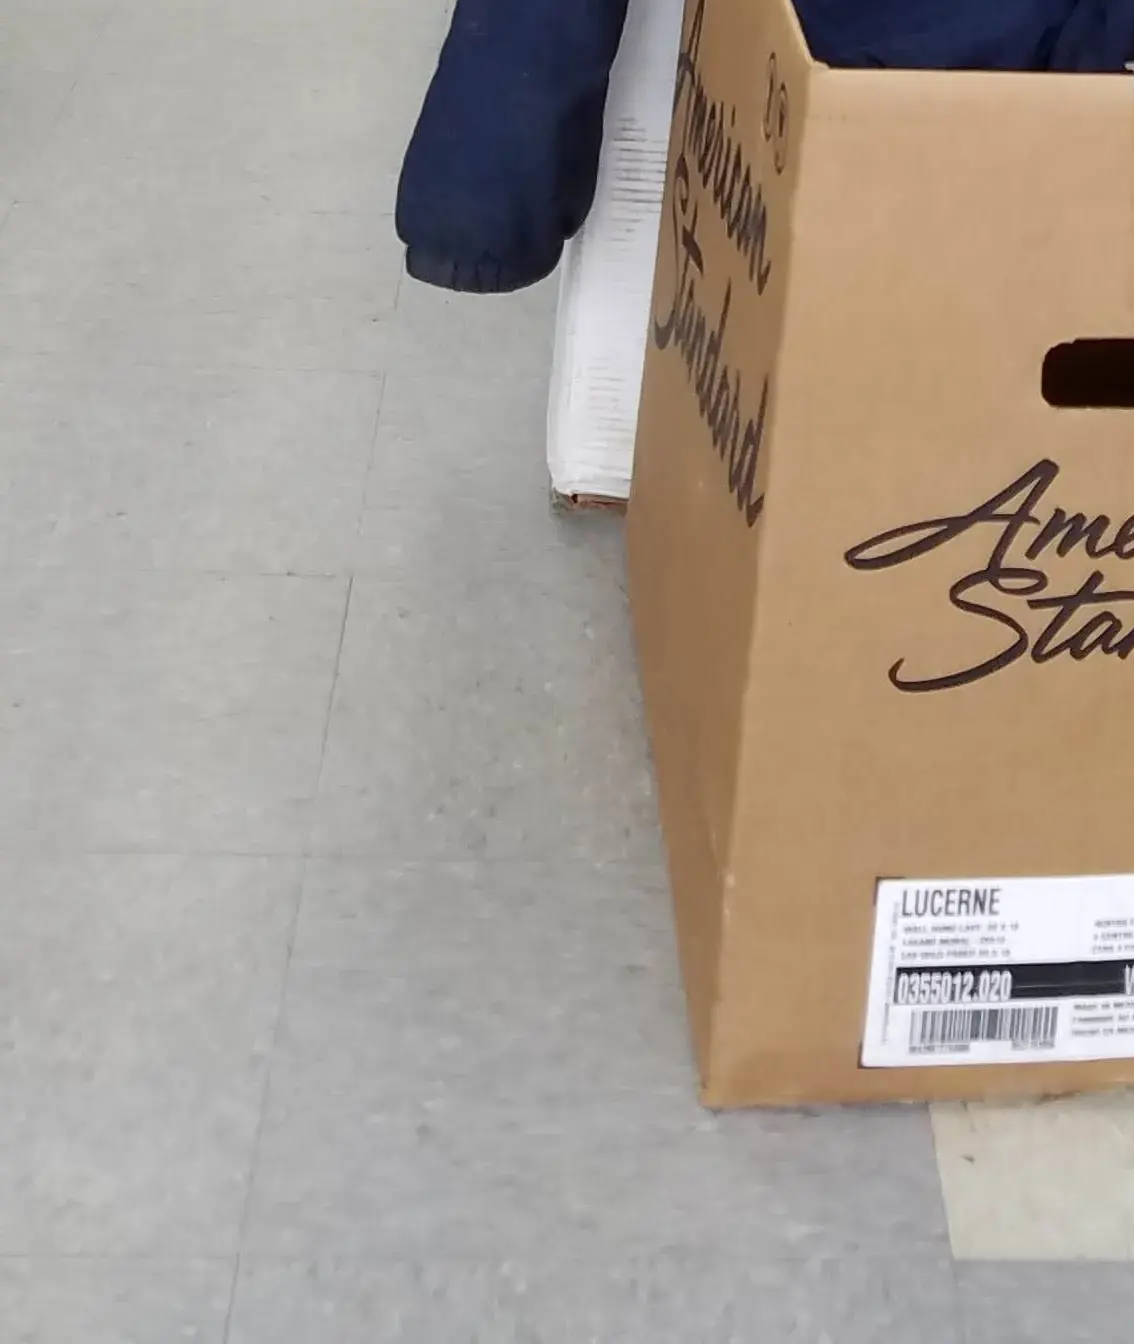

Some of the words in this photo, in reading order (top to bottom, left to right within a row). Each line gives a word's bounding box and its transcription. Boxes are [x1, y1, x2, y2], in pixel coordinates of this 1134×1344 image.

[653, 154, 766, 529] Standard
[901, 888, 1001, 917] LUCERNE
[897, 969, 1013, 1005] 0355012.020
